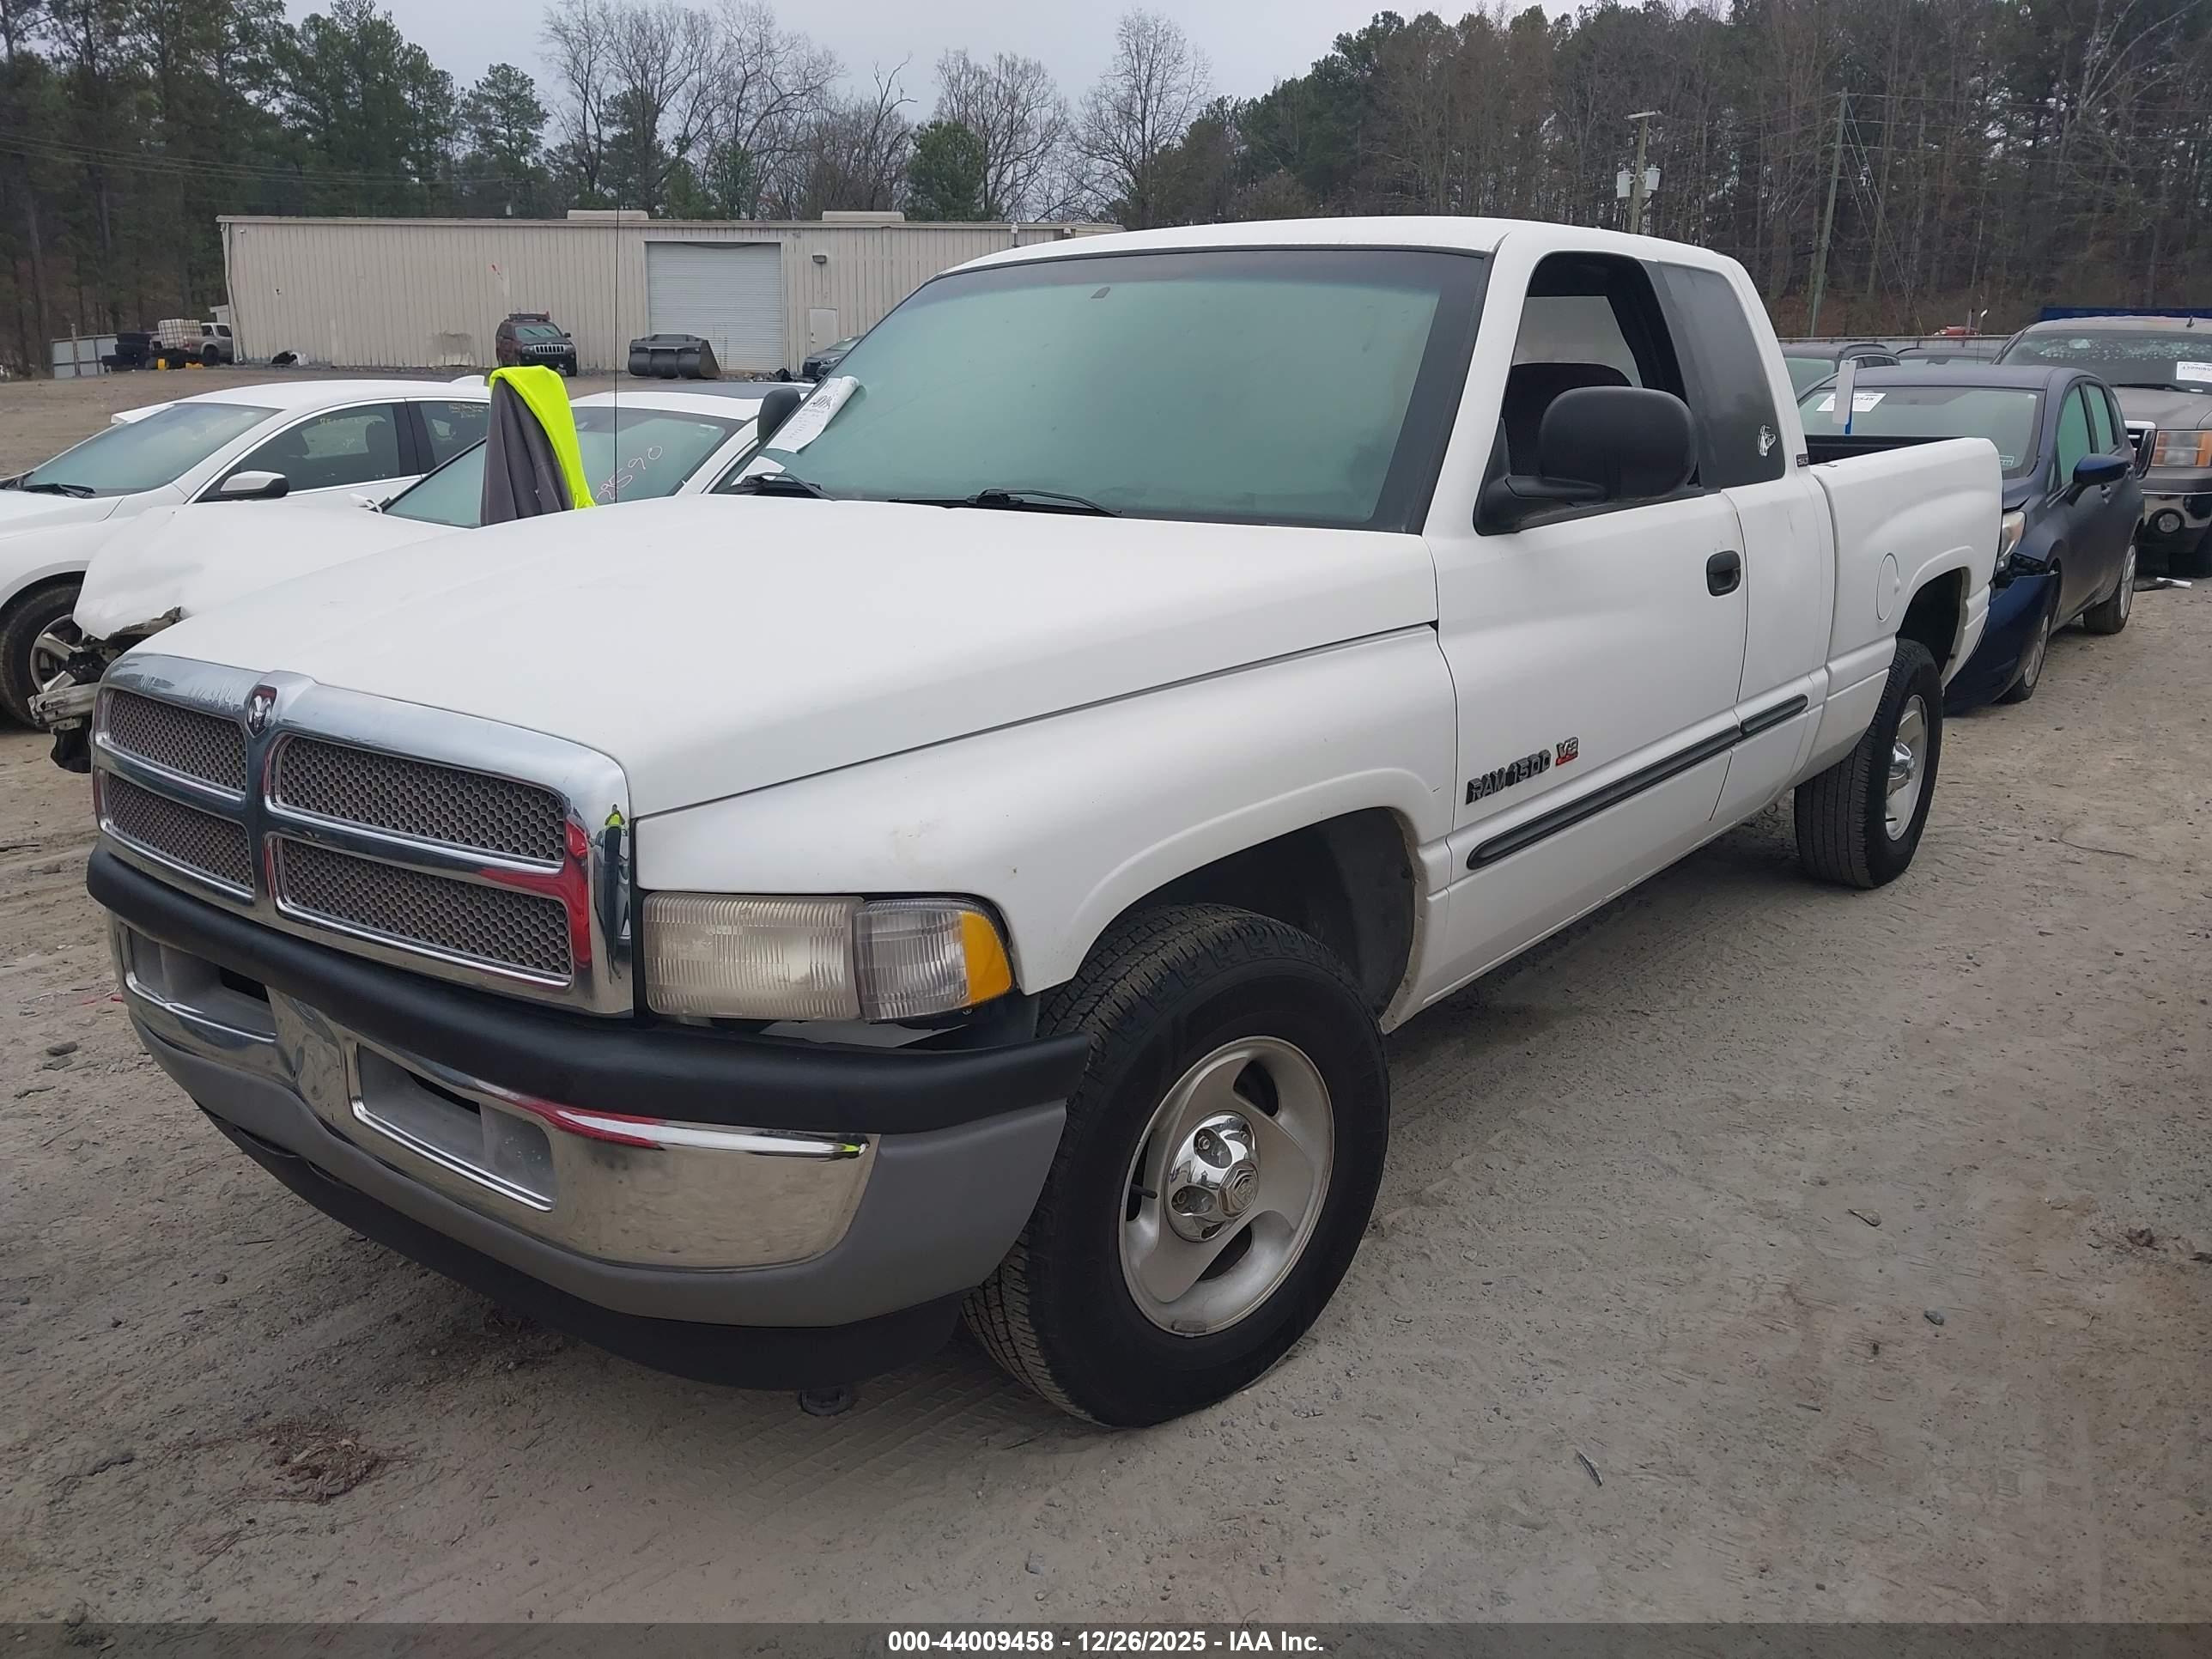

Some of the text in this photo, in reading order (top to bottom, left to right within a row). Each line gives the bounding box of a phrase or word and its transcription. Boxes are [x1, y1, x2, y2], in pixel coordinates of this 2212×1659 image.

[1466, 737, 1578, 805] RAM 1500 V8
